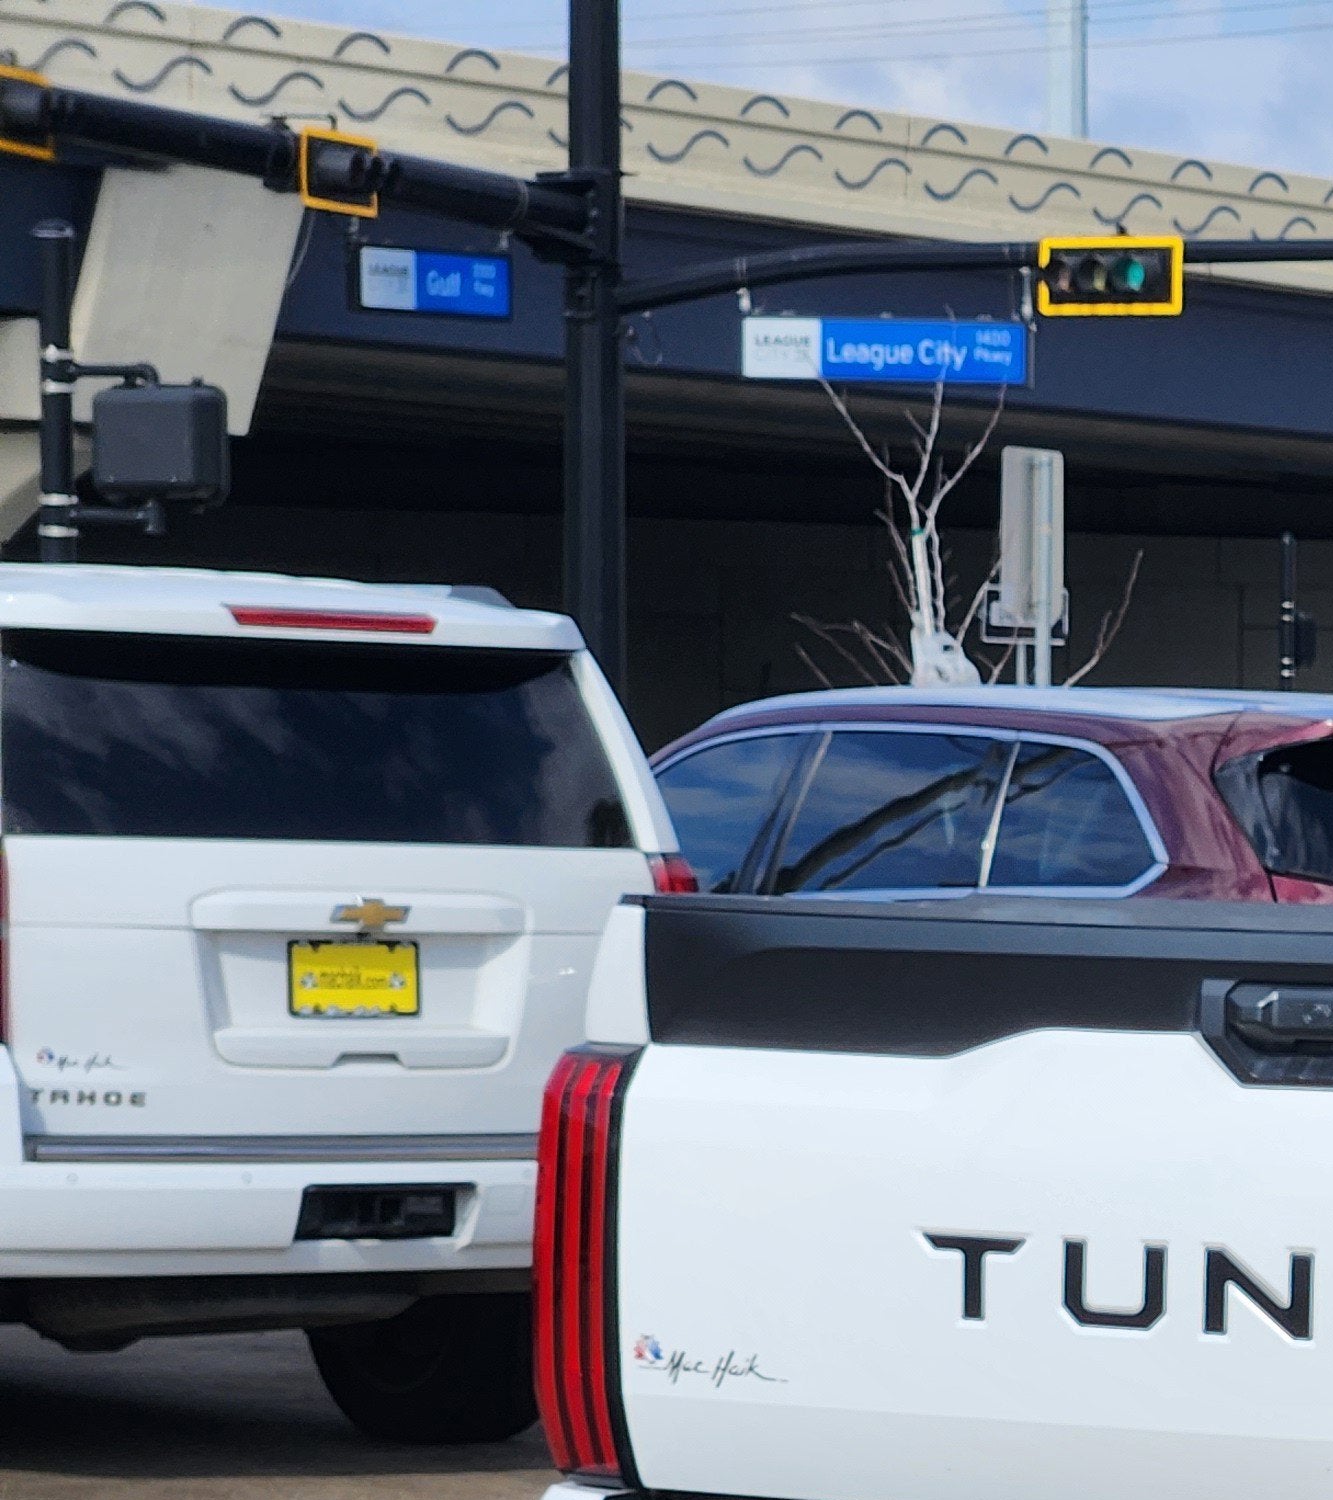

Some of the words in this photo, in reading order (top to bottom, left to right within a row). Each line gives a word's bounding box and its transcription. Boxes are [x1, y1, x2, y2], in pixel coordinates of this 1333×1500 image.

[753, 333, 811, 347] LEAGUE
[826, 336, 914, 371] League
[918, 337, 968, 372] City
[29, 1087, 146, 1108] TAHOE
[667, 1349, 709, 1385] Mac
[711, 1349, 785, 1388] Haik
